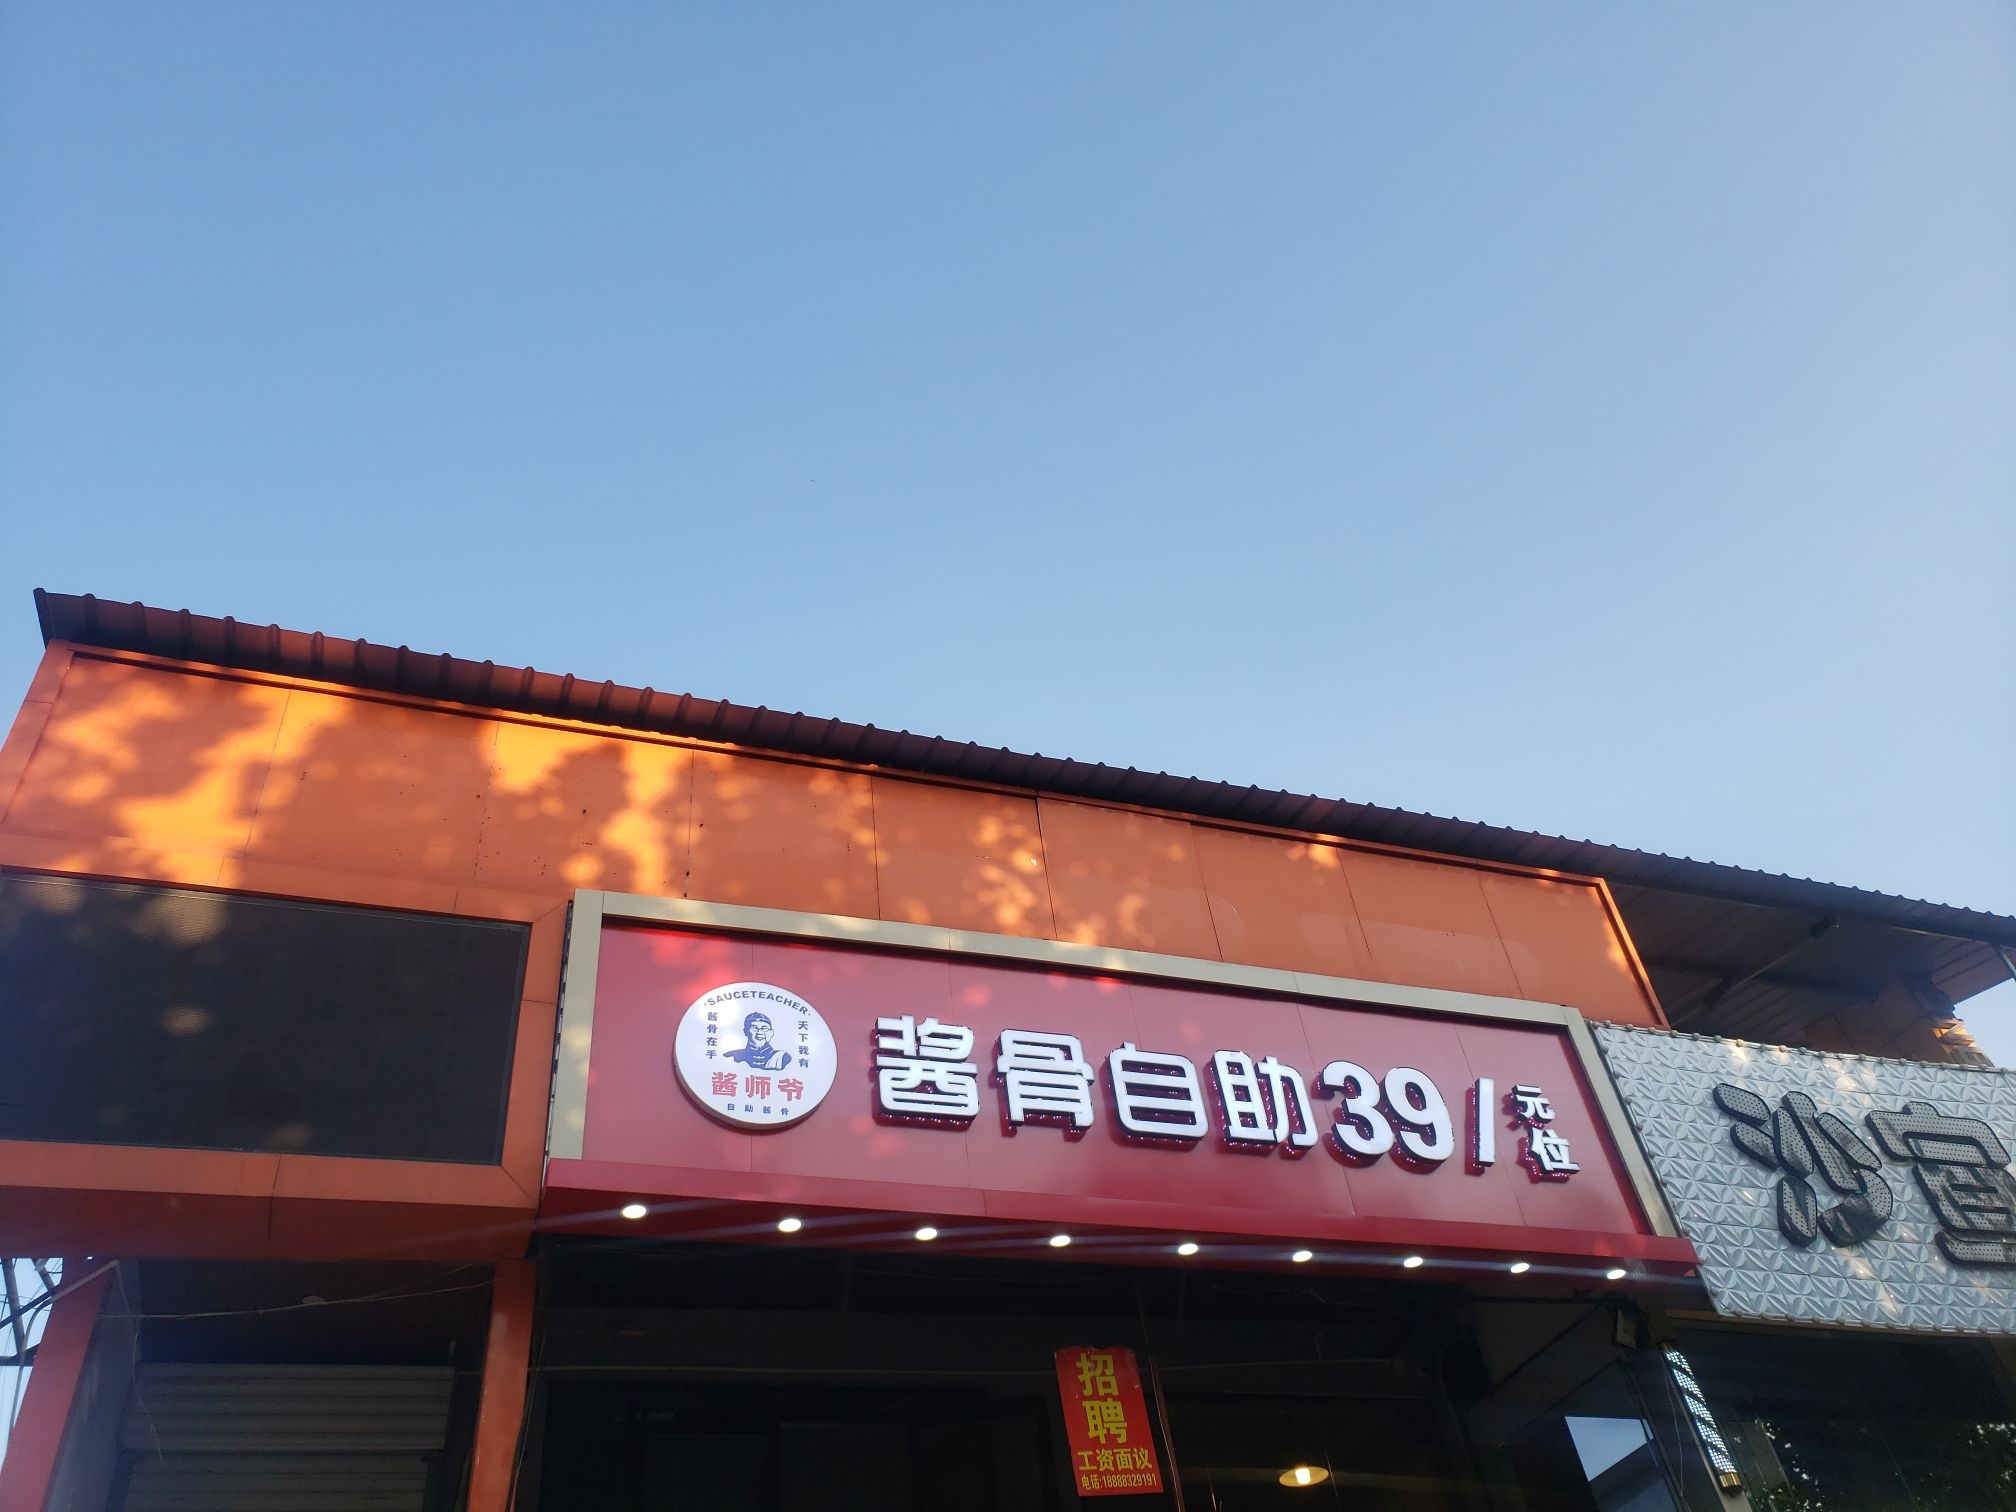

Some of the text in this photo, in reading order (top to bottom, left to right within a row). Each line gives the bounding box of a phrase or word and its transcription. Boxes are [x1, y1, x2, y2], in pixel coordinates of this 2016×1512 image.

[707, 990, 808, 1016] SAUCETEACHER
[798, 1020, 809, 1068] 天下我有
[711, 1071, 804, 1102] 酱师爷
[727, 1103, 789, 1116] 自助酱骨
[1075, 1353, 1128, 1444] 招聘
[1077, 1447, 1153, 1471] 工资面议
